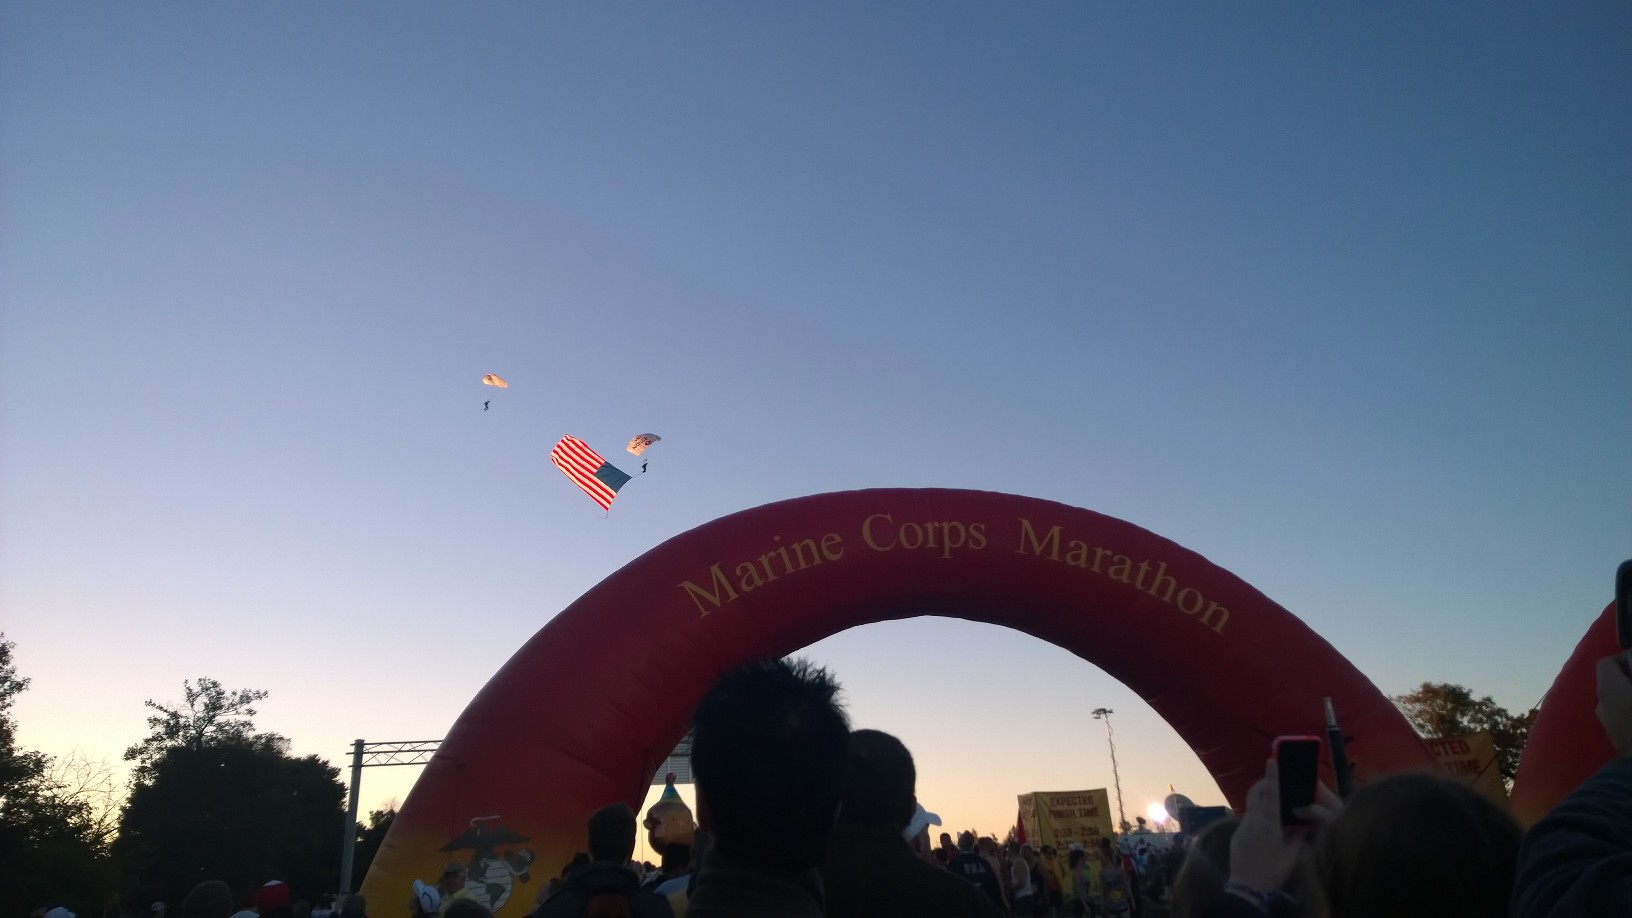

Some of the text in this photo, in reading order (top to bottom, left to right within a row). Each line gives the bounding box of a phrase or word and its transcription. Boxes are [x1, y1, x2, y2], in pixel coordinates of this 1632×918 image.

[677, 513, 1232, 635] Marine Corps Marathon
[1431, 740, 1470, 756] CTED
[1443, 759, 1482, 774] TIME
[1049, 796, 1094, 806] EXPECTED
[1048, 807, 1100, 818] FINISH TIME
